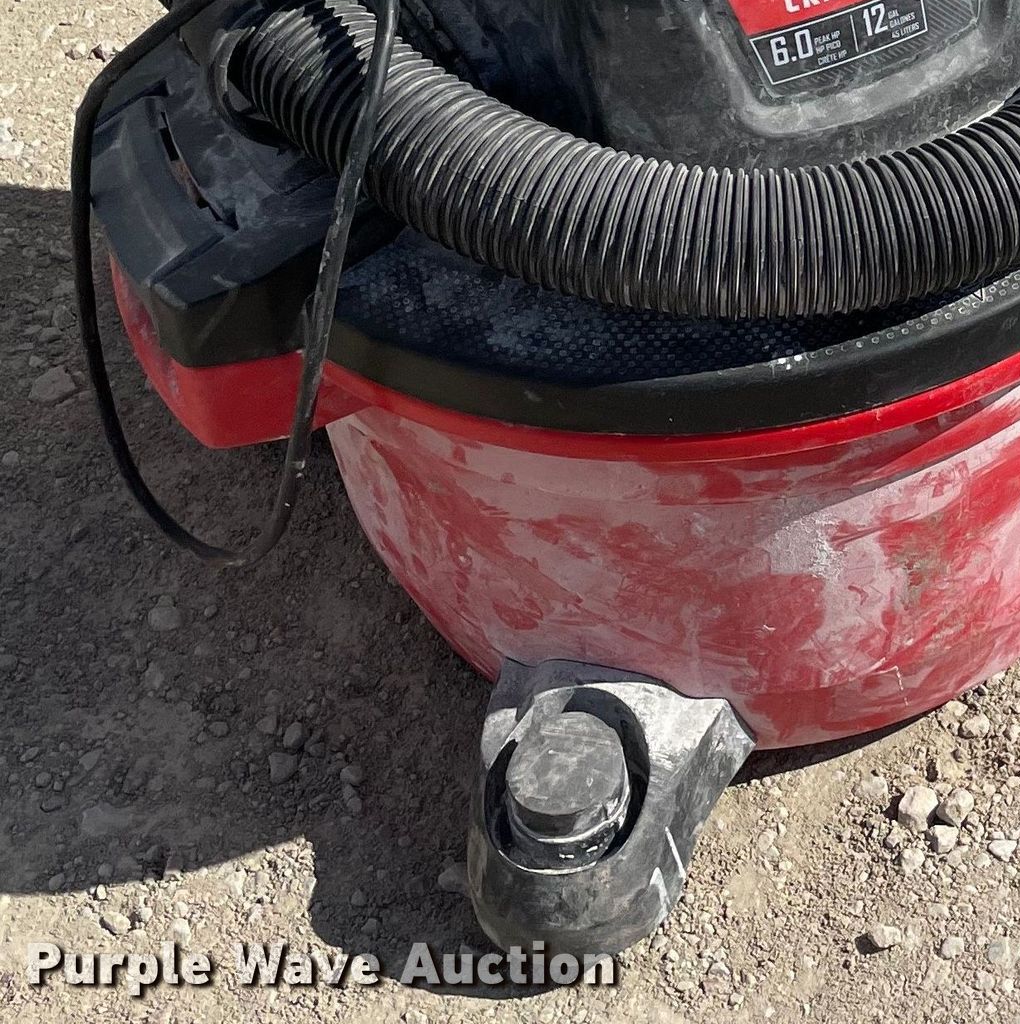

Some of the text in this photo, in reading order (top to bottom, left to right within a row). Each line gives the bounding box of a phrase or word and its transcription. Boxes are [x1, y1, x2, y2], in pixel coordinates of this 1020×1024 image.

[863, 3, 888, 37] 12
[887, 8, 900, 19] GAL
[814, 30, 841, 45] PEAK HP
[769, 28, 814, 66] 6.0
[815, 39, 842, 55] HP PICO
[839, 49, 848, 60] HP
